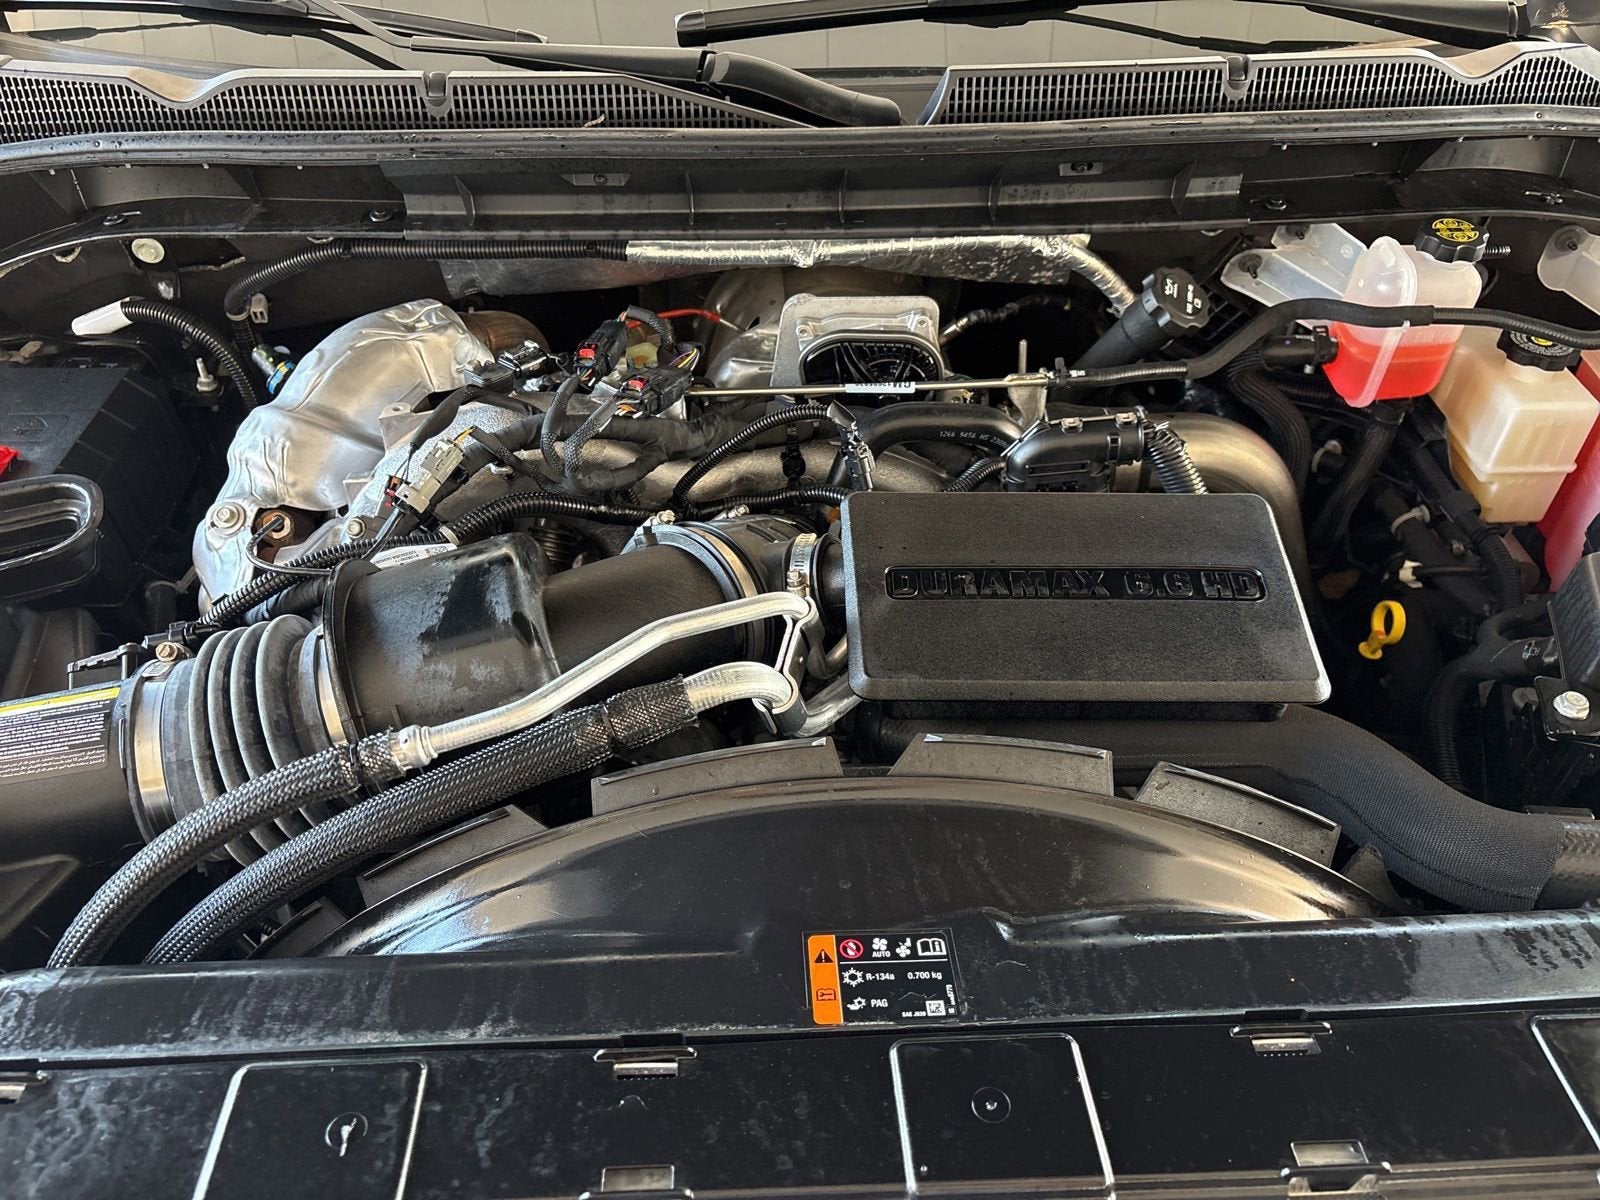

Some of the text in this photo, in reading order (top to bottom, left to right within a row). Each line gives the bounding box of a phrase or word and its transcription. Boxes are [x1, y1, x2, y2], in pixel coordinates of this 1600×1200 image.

[891, 570, 1261, 599] DURAMAX 6.6 HD
[866, 971, 943, 980] R-134a 0.700 kg
[870, 999, 889, 1008] PAG
